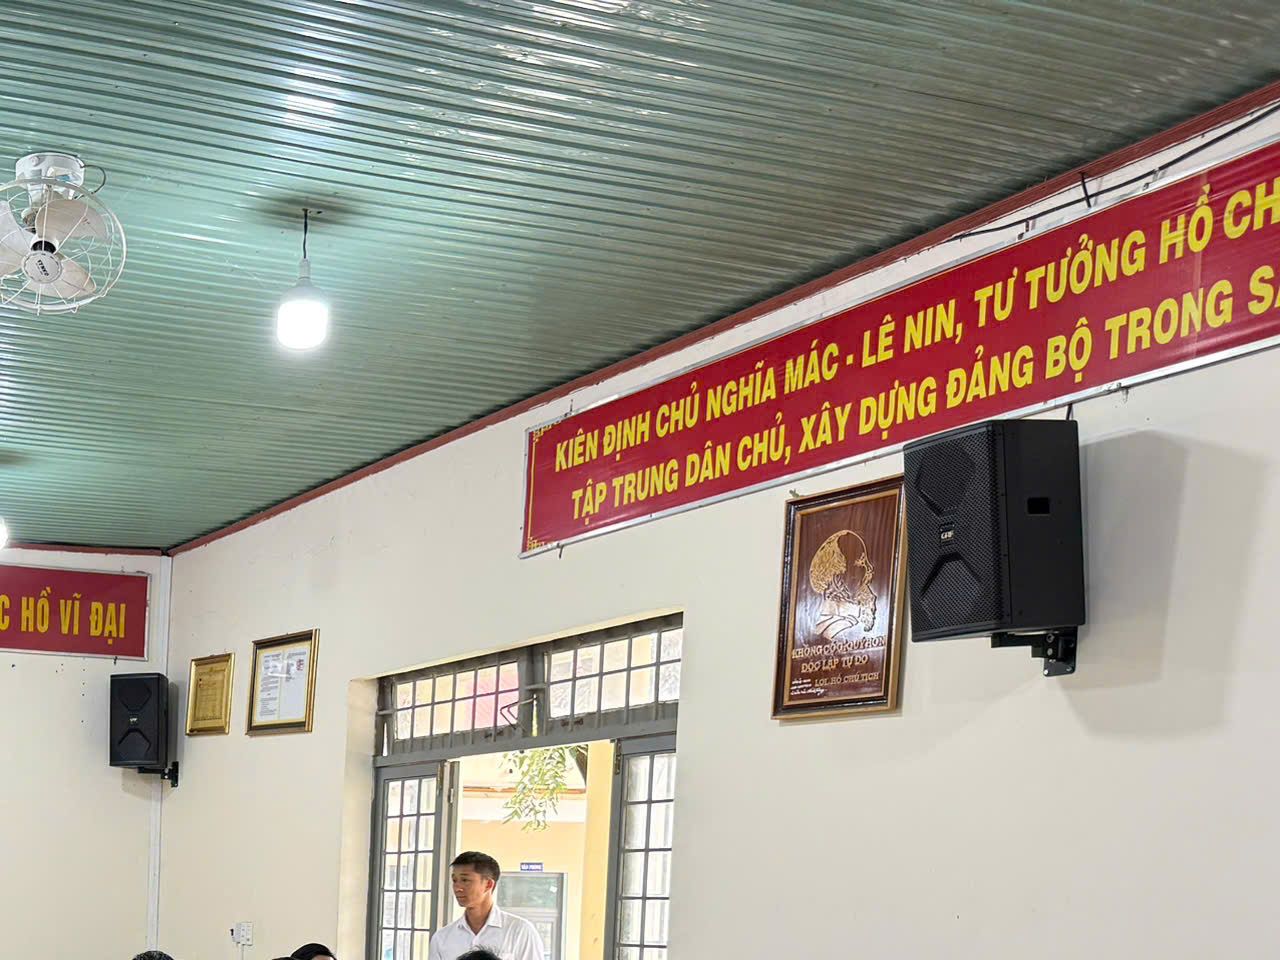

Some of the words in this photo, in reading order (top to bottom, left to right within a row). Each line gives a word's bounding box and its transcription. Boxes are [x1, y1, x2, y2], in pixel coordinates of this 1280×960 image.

[555, 431, 598, 473] KIÊN
[603, 410, 650, 461] ĐỊNH
[655, 382, 700, 438] CHỦ
[706, 356, 777, 422] NGHĨA
[784, 340, 839, 395] MÁC
[861, 315, 895, 368] LÊ
[903, 298, 962, 353] NIN,
[975, 267, 1018, 328] TƯ
[1025, 234, 1146, 310] TƯỞNG
[1159, 183, 1214, 265] HỒ
[1223, 175, 1280, 240] CH
[572, 481, 607, 525] TẬP
[612, 459, 679, 510] TRUNG
[685, 441, 731, 487] DÂN
[737, 411, 791, 473] CHỦ,
[798, 402, 851, 453] XÂY
[859, 377, 937, 440] DỰNG
[945, 344, 1034, 409] ĐẢNG
[1045, 317, 1093, 383] BỘ
[1104, 279, 1233, 360] TRONG
[21, 587, 51, 632] HỒ
[60, 593, 81, 635] VĨ
[89, 602, 126, 644] ĐẠI
